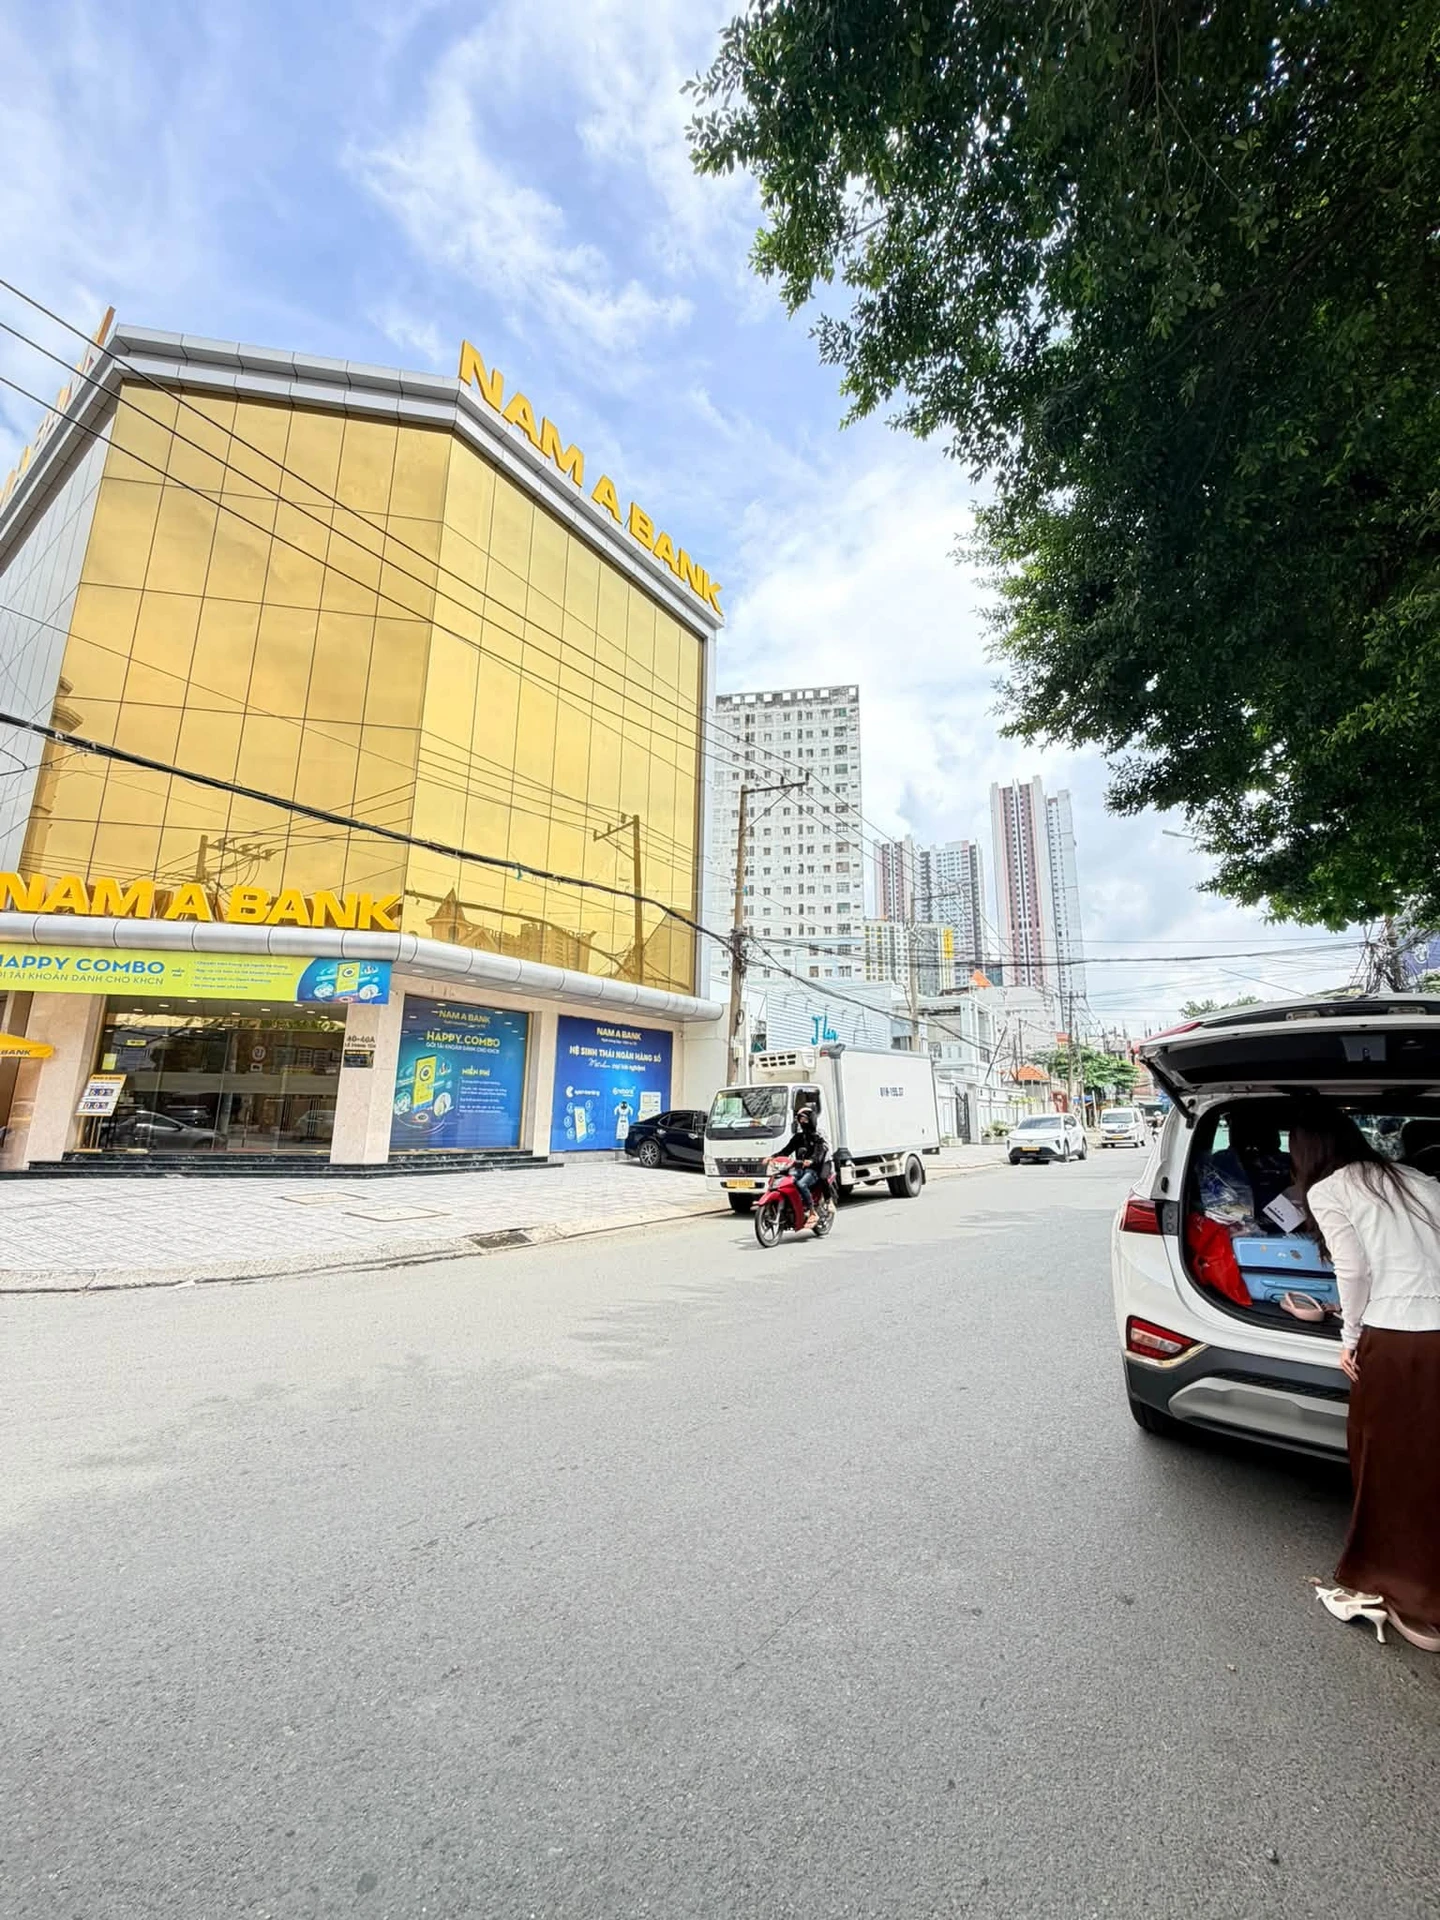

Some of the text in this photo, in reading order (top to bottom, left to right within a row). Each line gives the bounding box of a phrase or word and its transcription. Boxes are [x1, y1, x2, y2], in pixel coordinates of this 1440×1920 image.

[459, 339, 722, 616] NAM A BANK
[0, 872, 403, 932] NAM A BANK
[0, 955, 70, 970] APPY
[75, 958, 165, 974] COMBO
[104, 975, 130, 983] CHO
[132, 977, 164, 985] KHCN
[438, 1010, 460, 1020] NAM
[468, 1013, 491, 1024] BANK
[426, 1031, 500, 1048] HAPPY COMBO
[596, 1027, 614, 1037] NAM
[621, 1030, 642, 1040] BANK
